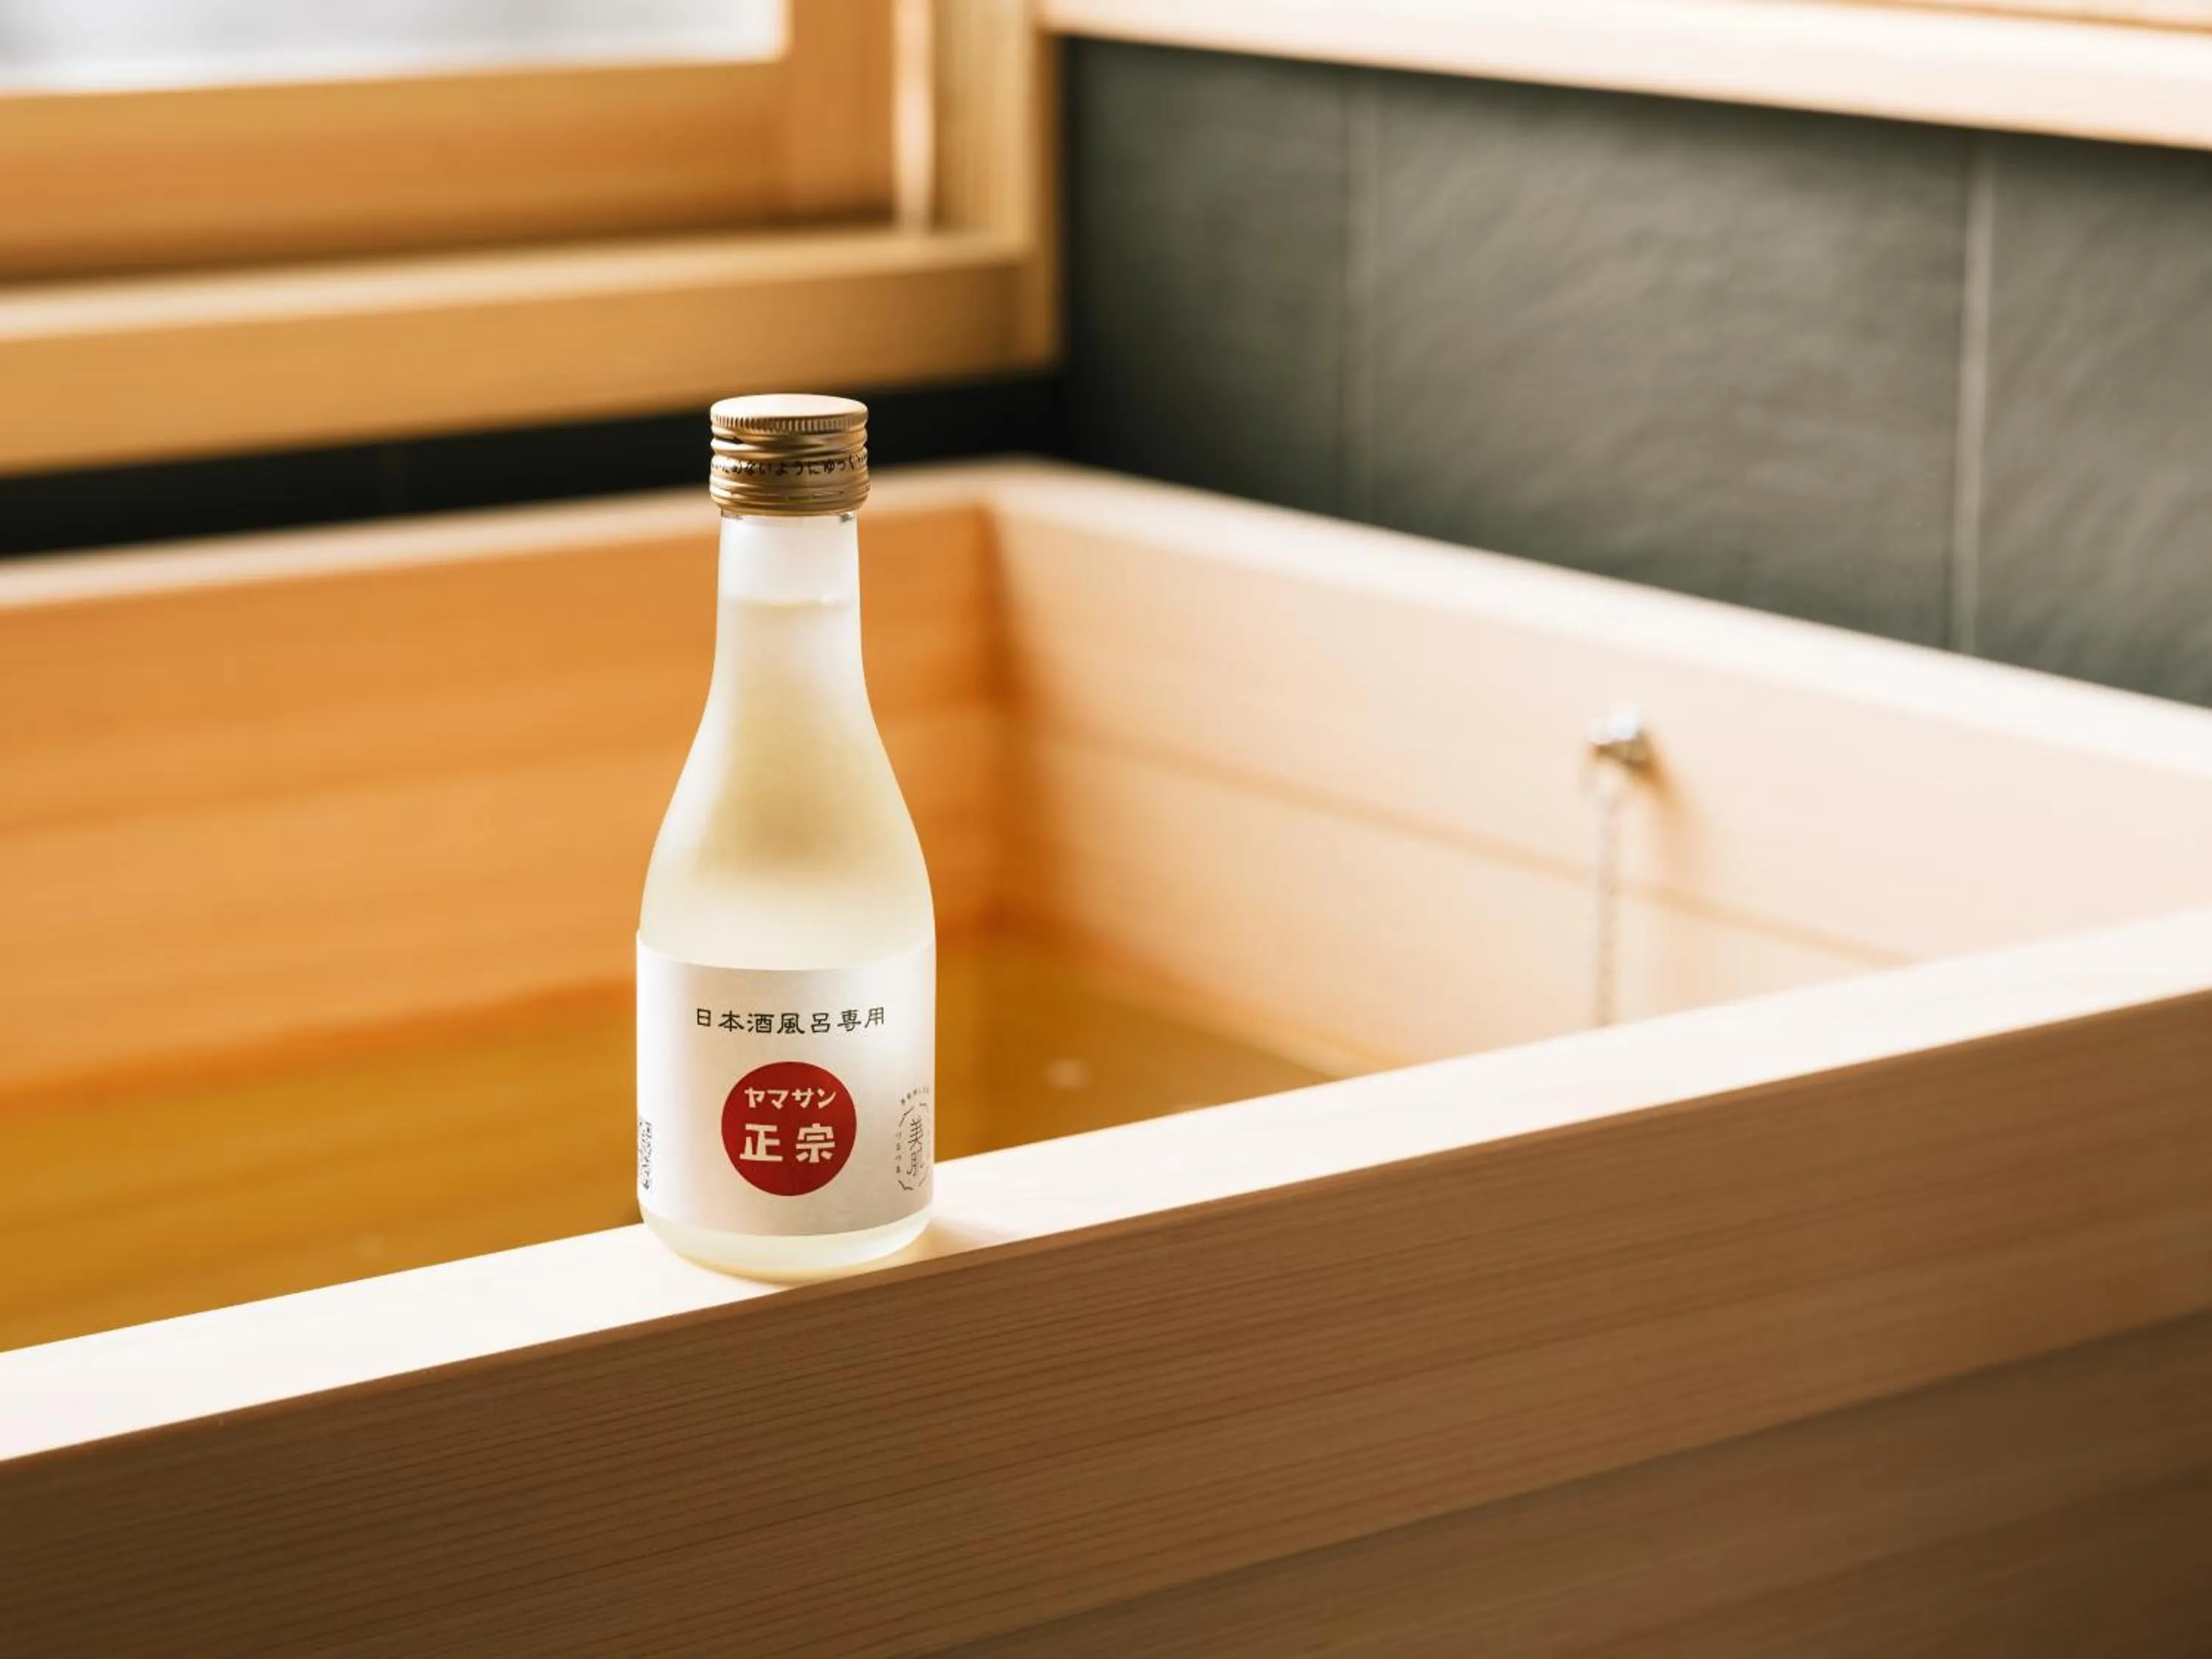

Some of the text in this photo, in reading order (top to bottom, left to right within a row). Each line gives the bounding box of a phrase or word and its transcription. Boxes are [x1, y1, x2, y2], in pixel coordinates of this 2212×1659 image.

[696, 1006, 886, 1034] 日本酒風呂専用
[744, 1086, 837, 1110] ヤマサン
[739, 1122, 836, 1164] 正宗
